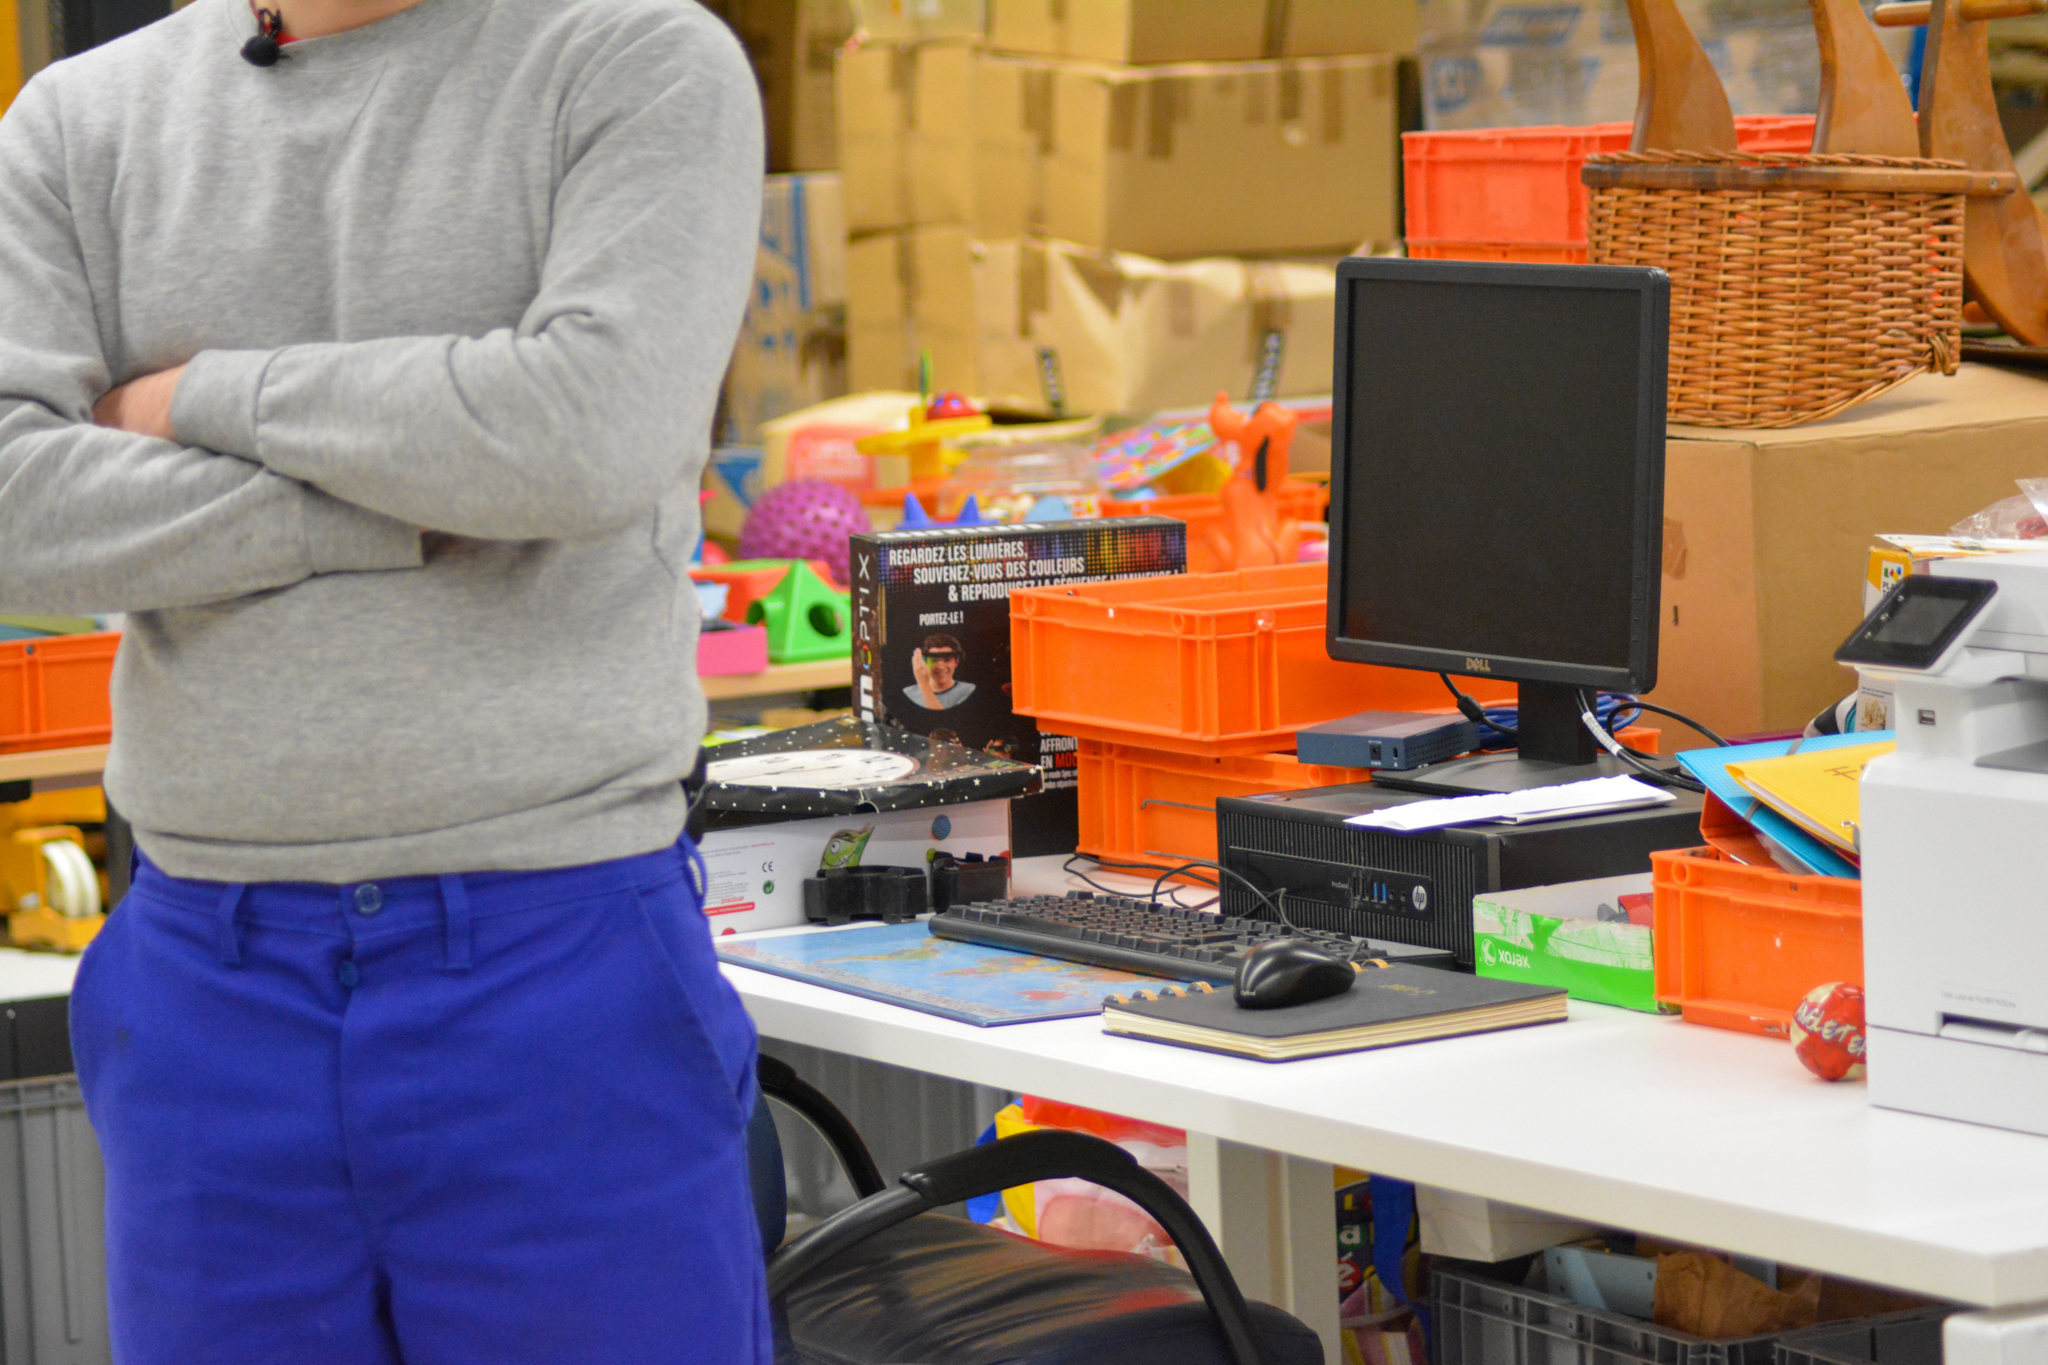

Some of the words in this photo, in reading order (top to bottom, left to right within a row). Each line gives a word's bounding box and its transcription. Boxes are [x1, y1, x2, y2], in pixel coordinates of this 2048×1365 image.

[889, 546, 946, 566] REGARDEZ
[947, 544, 967, 563] LES
[969, 538, 1029, 561] LUMIÈRES,
[913, 563, 1004, 585] SOUVENEZ-VOUS
[1006, 561, 1027, 578] DES
[1028, 557, 1086, 576] COULEURS
[948, 584, 959, 602] &
[919, 612, 960, 626] PORTEZ-LE
[1466, 657, 1491, 673] DELL
[1041, 754, 1054, 769] EN
[1413, 886, 1426, 910] hp
[1499, 948, 1531, 968] xerox
